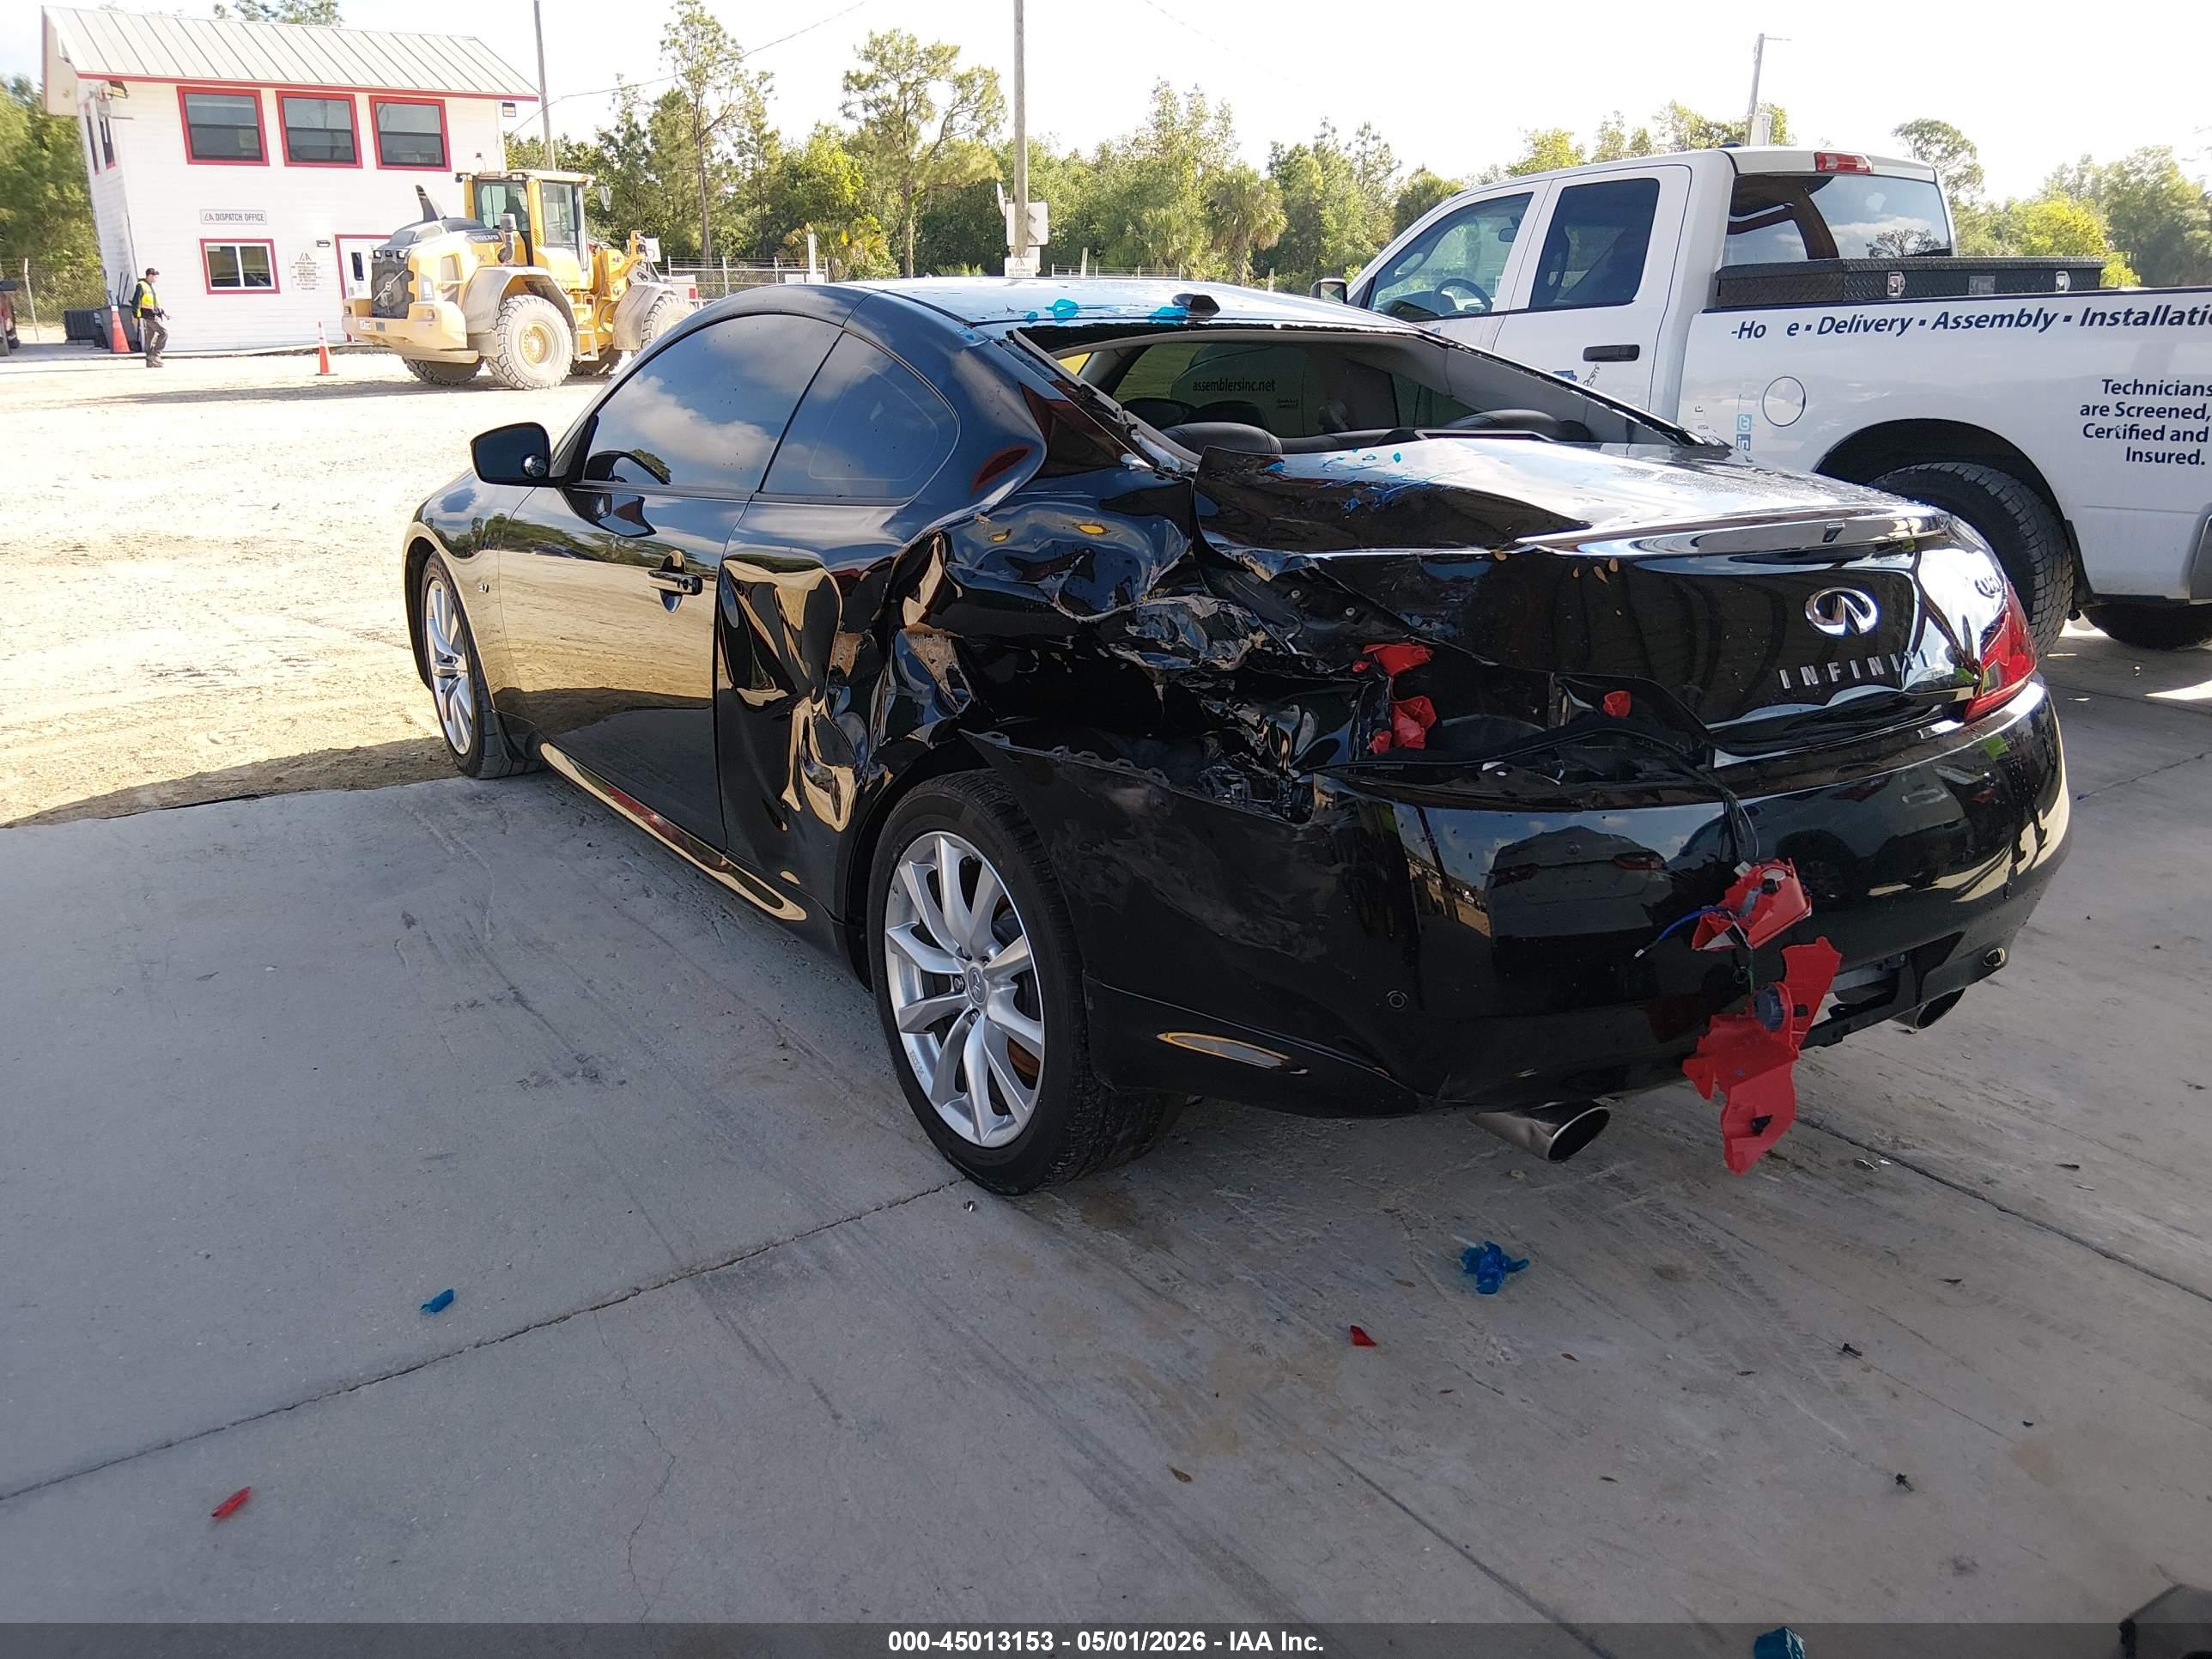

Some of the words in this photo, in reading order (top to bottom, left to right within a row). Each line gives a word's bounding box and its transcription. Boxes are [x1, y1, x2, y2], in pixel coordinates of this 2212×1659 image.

[215, 212, 243, 222] DISPATCH
[244, 213, 264, 222] OFFICE
[1817, 313, 1914, 337] Delivery
[1930, 307, 2059, 333] Assembly
[2079, 304, 2212, 327] Installati
[2101, 379, 2212, 398] Technicians
[2080, 404, 2111, 417] are
[2114, 401, 2212, 422] Screened,
[2169, 426, 2209, 443] and
[2125, 446, 2205, 465] Insured.
